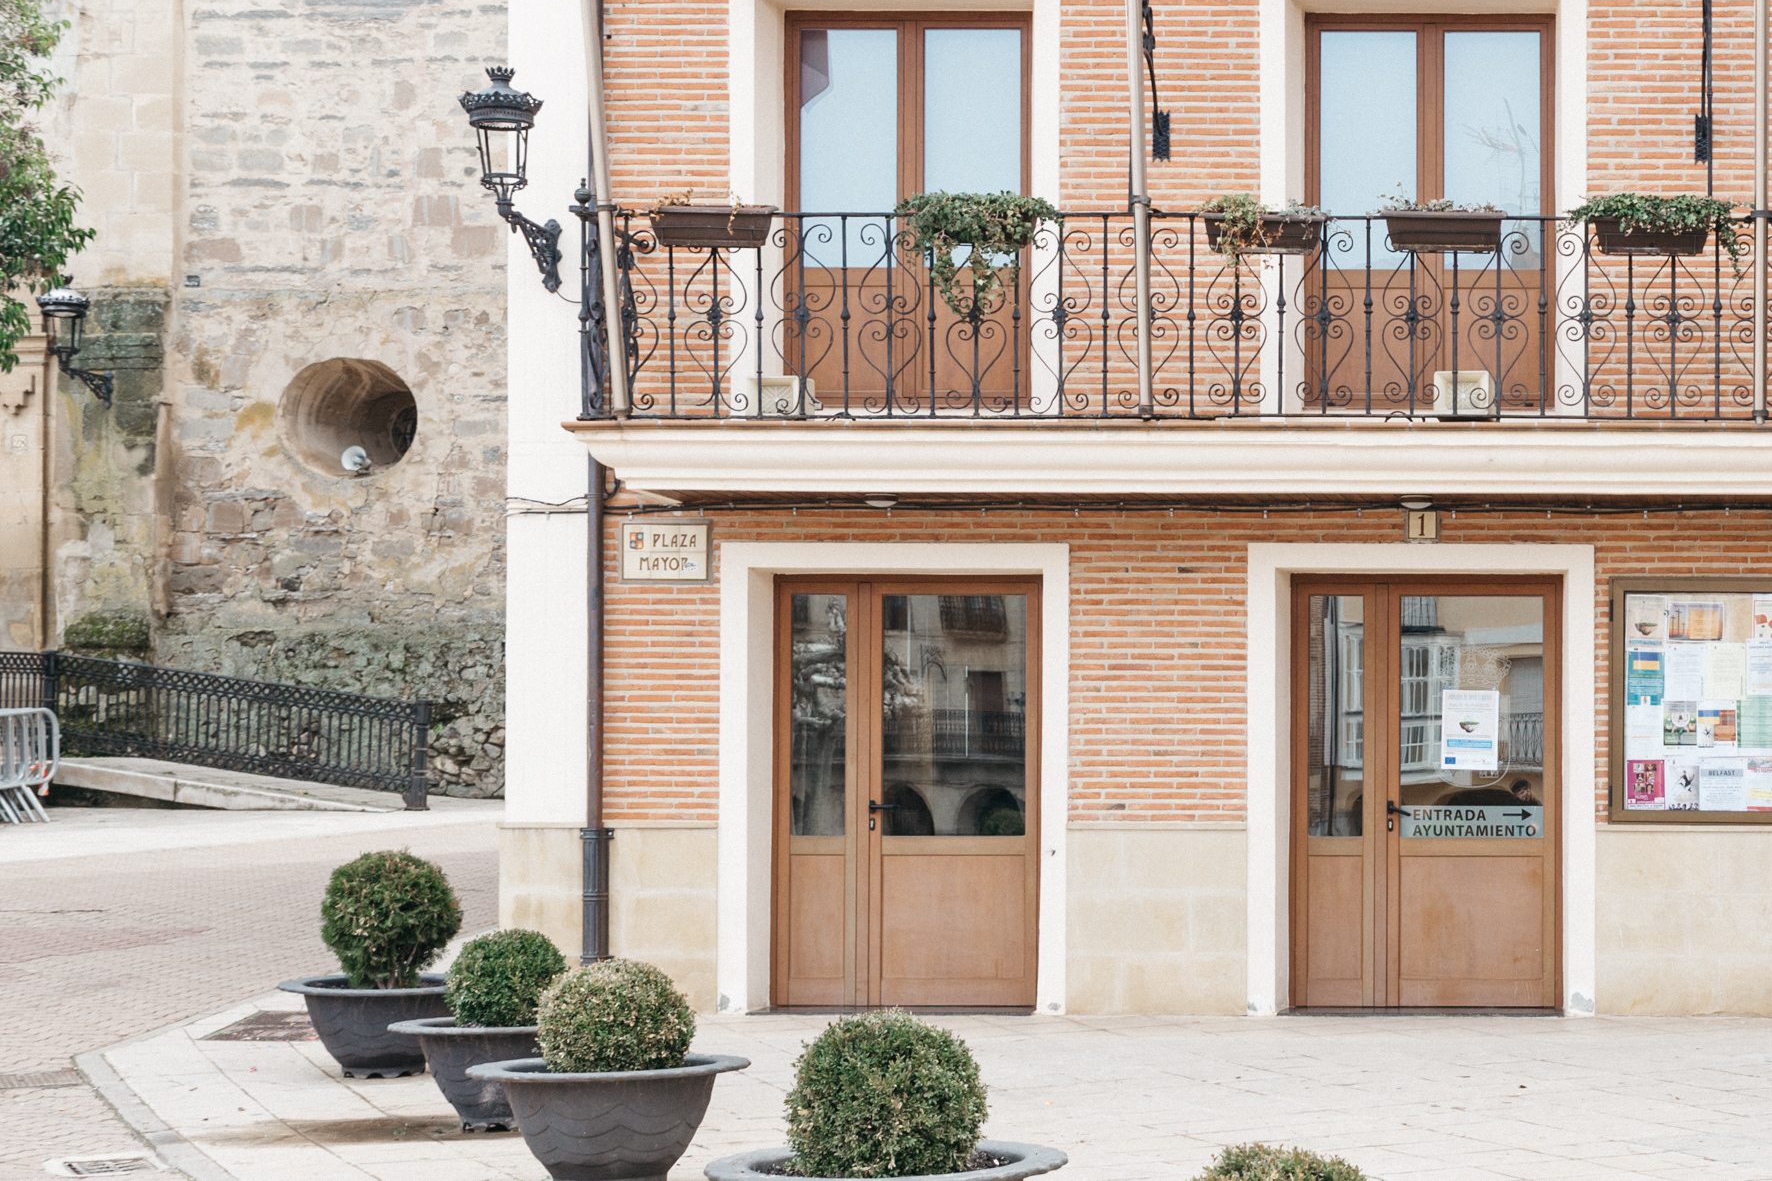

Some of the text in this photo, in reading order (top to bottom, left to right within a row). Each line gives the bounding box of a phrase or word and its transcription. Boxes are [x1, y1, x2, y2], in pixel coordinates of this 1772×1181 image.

[1417, 513, 1426, 537] 1
[653, 534, 696, 548] PLAZA
[1412, 809, 1487, 822] ENTRADA
[1412, 824, 1537, 837] AYUNTAMIENTO
